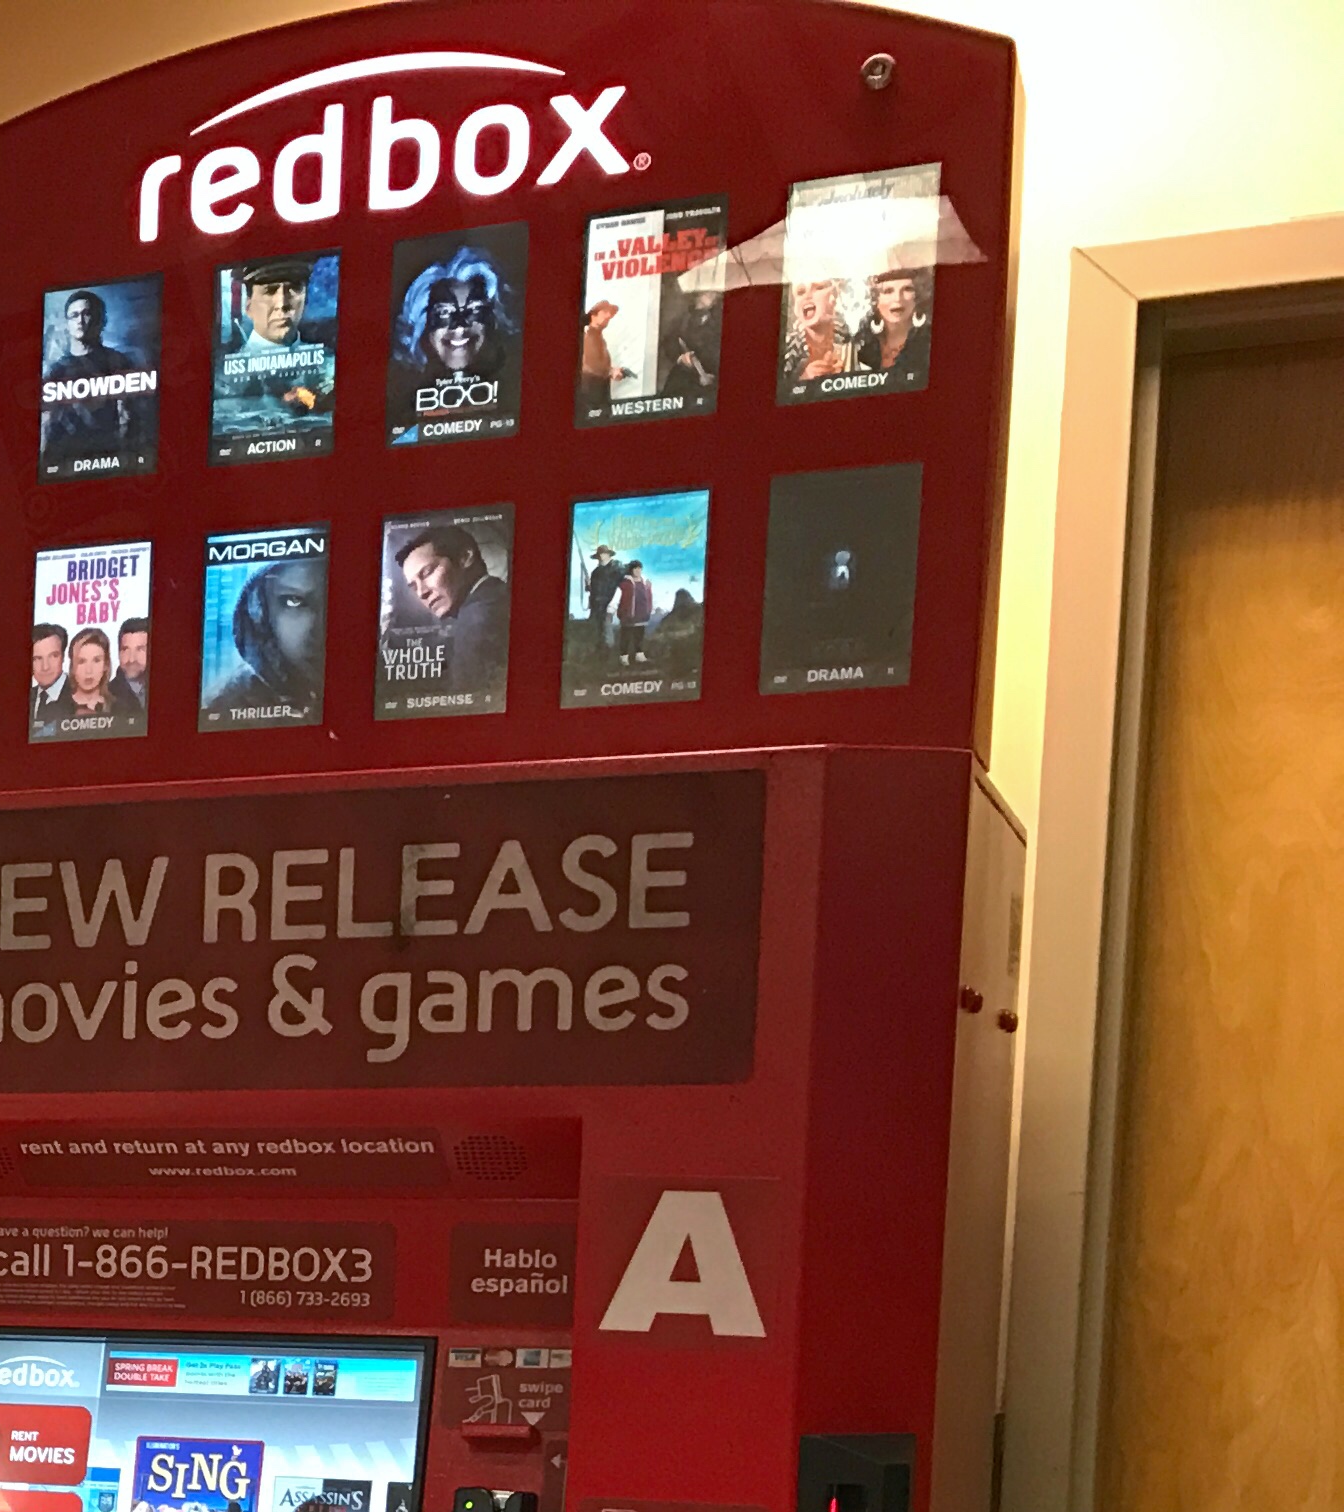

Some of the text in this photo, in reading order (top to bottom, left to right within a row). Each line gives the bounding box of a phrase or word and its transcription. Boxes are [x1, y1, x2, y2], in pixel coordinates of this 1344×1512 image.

[138, 85, 631, 242] redbox
[224, 360, 245, 375] USS
[248, 350, 325, 373] INDIANAPOLIS
[42, 370, 157, 403] SNOWDEN
[821, 372, 888, 392] COMEDY
[416, 381, 498, 411] BOO!
[610, 396, 684, 418] WESTERN
[423, 419, 482, 436] COMEDY
[247, 439, 296, 455] ACTION
[73, 456, 120, 473] DRAMA
[209, 537, 324, 561] MORGAN
[67, 554, 140, 582] BRIDGET
[46, 578, 119, 606] JONES'S
[76, 600, 121, 625] BABY
[382, 645, 445, 665] WHOLE
[385, 662, 442, 681] TRUTH
[806, 666, 864, 683] DRAMA
[601, 680, 663, 696] COMEDY
[406, 694, 474, 708] SUSPENSE
[229, 705, 291, 721] THRILLER
[61, 716, 113, 732] COMEDY
[203, 831, 695, 943] RELEASE
[268, 952, 333, 1038] &
[359, 963, 689, 1063] games
[20, 1137, 435, 1158] rent and return at any redbox location
[148, 1165, 297, 1177] www.redbox.com
[22, 1228, 29, 1237] a
[32, 1226, 89, 1239] question?
[92, 1228, 110, 1238] we
[113, 1228, 135, 1238] can
[138, 1227, 168, 1240] help!
[63, 1243, 372, 1283] 1-866-REDBOX3
[484, 1248, 557, 1269] Hablo
[598, 1190, 767, 1337] A
[471, 1273, 568, 1297] español
[240, 1290, 370, 1308] 1 (866) 733-2693
[115, 1362, 173, 1373] SPRING BREAK
[519, 1382, 564, 1395] swipe
[519, 1396, 551, 1409] card
[11, 1430, 39, 1442] RENT
[9, 1445, 76, 1465] MOVIES
[147, 1452, 251, 1501] SING
[279, 1487, 363, 1511] ASSASSIN'S
